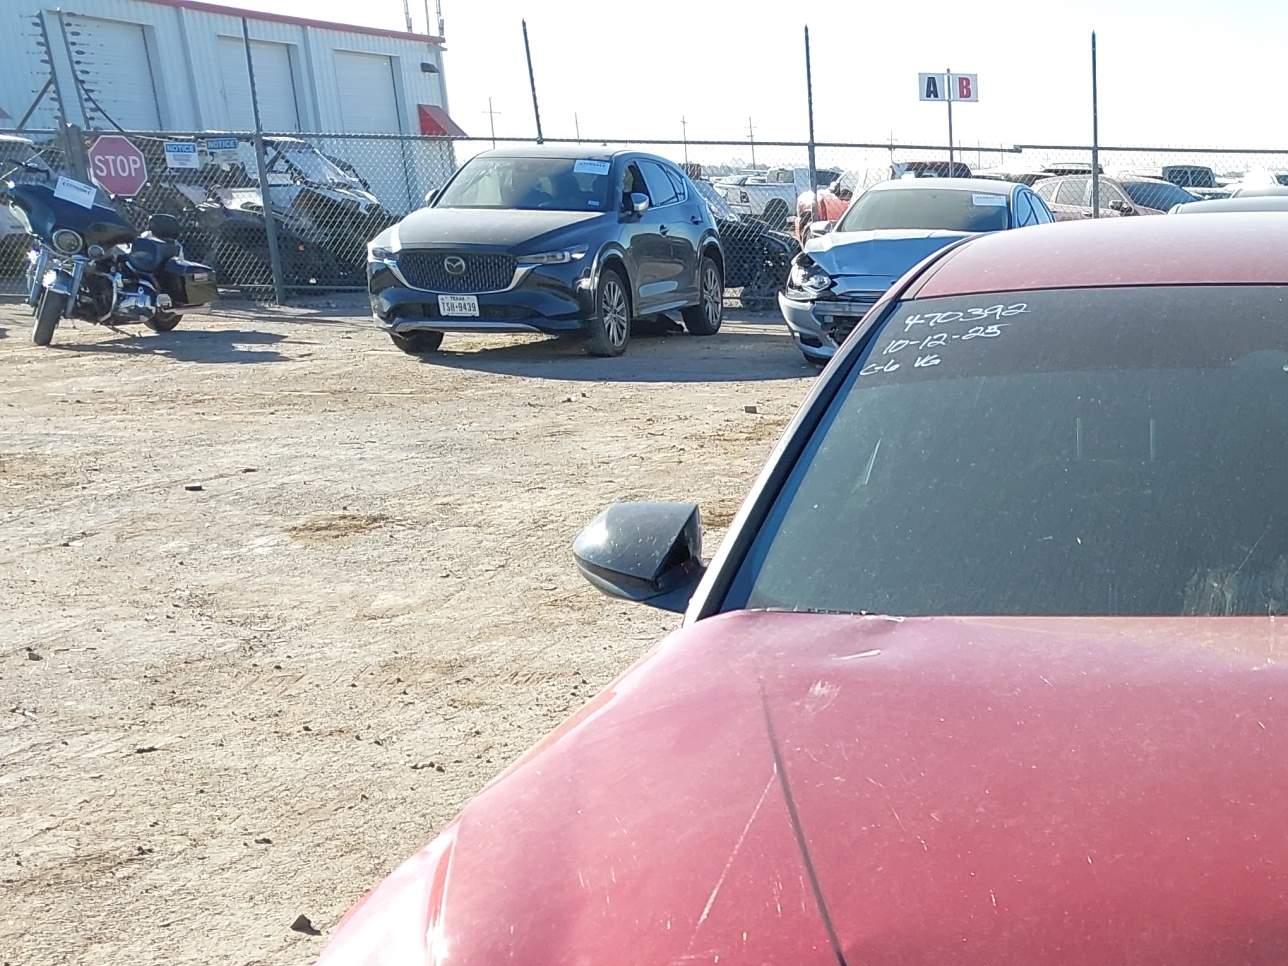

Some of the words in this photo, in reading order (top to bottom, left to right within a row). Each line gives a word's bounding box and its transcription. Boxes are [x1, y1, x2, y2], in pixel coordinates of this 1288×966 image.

[925, 76, 939, 98] A
[958, 76, 972, 99] B
[167, 144, 194, 153] NOTICE
[208, 139, 235, 149] NOTICE
[94, 155, 141, 177] STOP
[904, 302, 1032, 332] 470392
[882, 323, 1010, 355] 10-12-25
